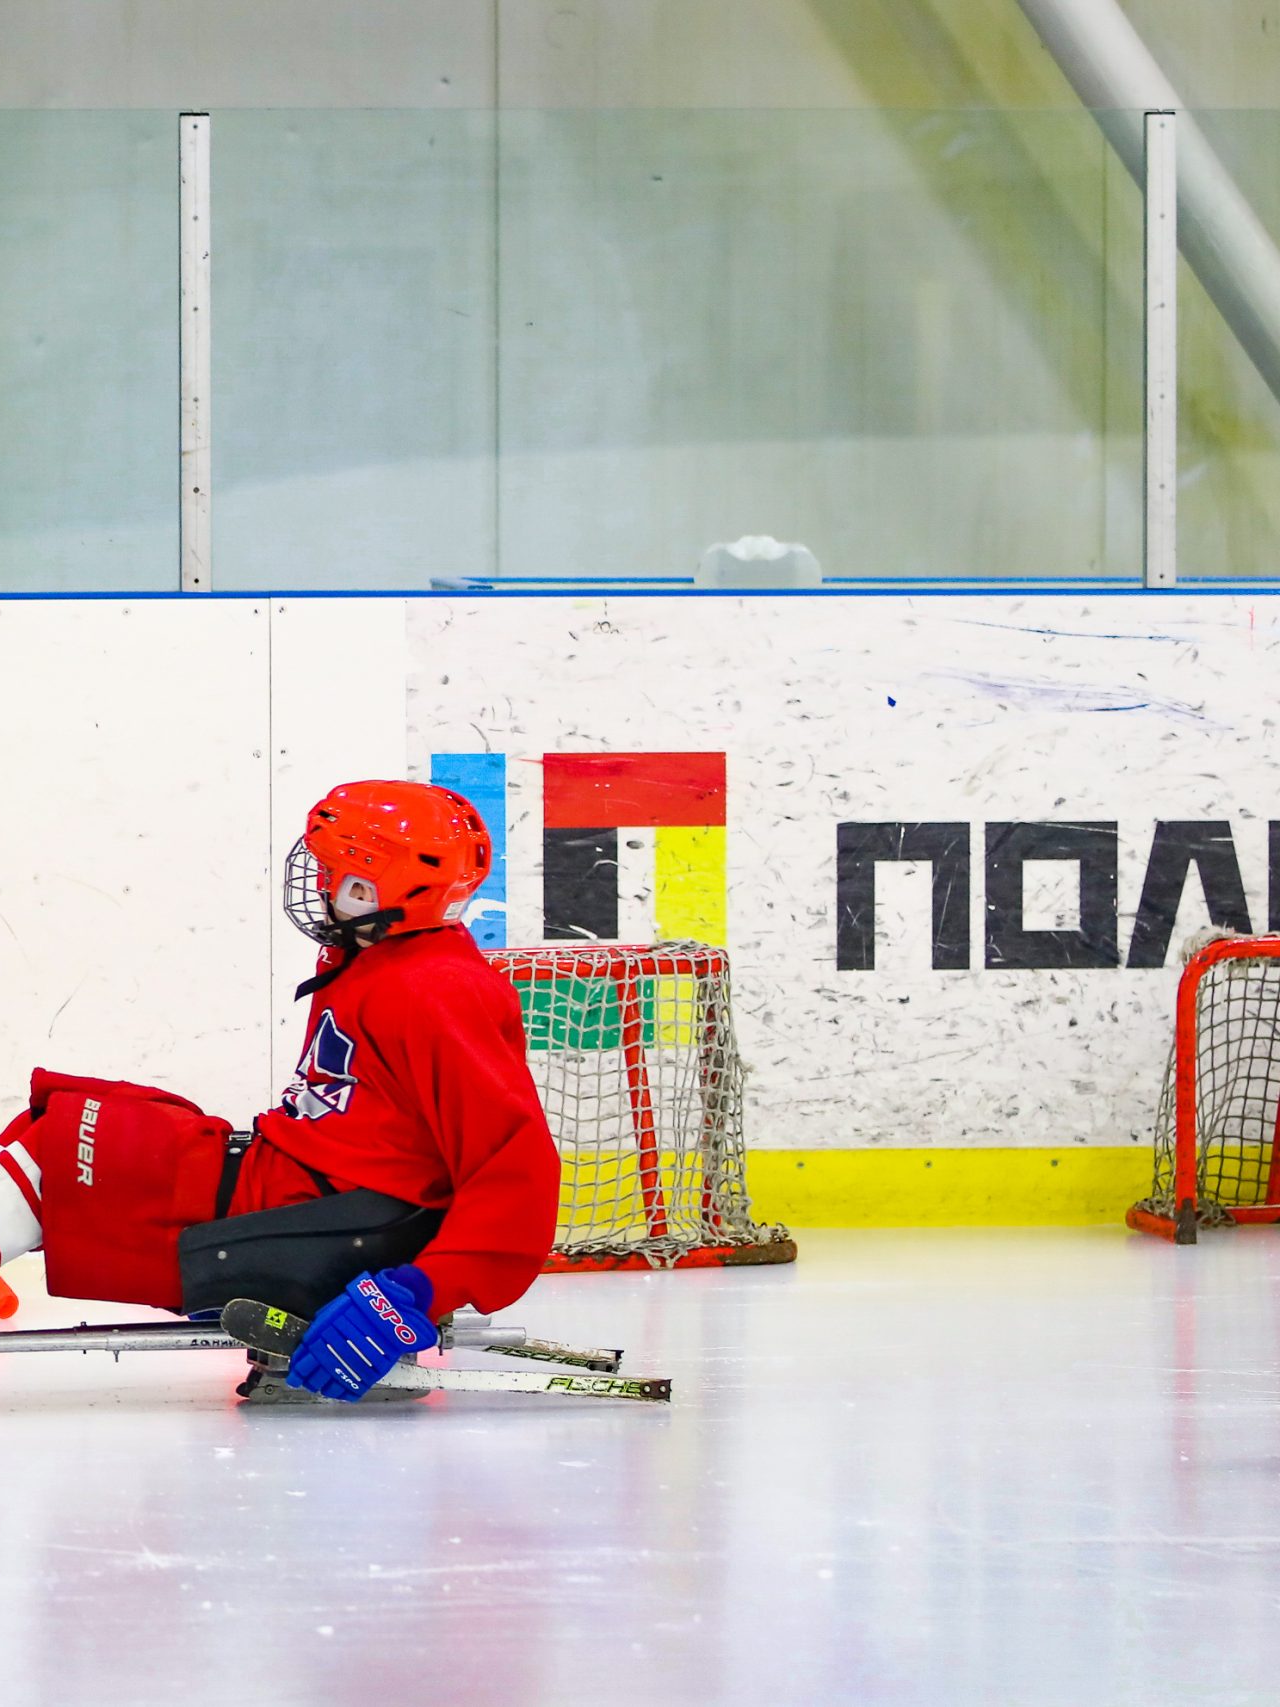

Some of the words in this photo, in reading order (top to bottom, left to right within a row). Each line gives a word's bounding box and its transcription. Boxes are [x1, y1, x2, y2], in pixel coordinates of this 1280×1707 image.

[837, 820, 1280, 970] ПОЛ
[76, 1097, 102, 1187] BAUER
[484, 1345, 590, 1369] FISCHE
[545, 1377, 642, 1394] FISCHE
